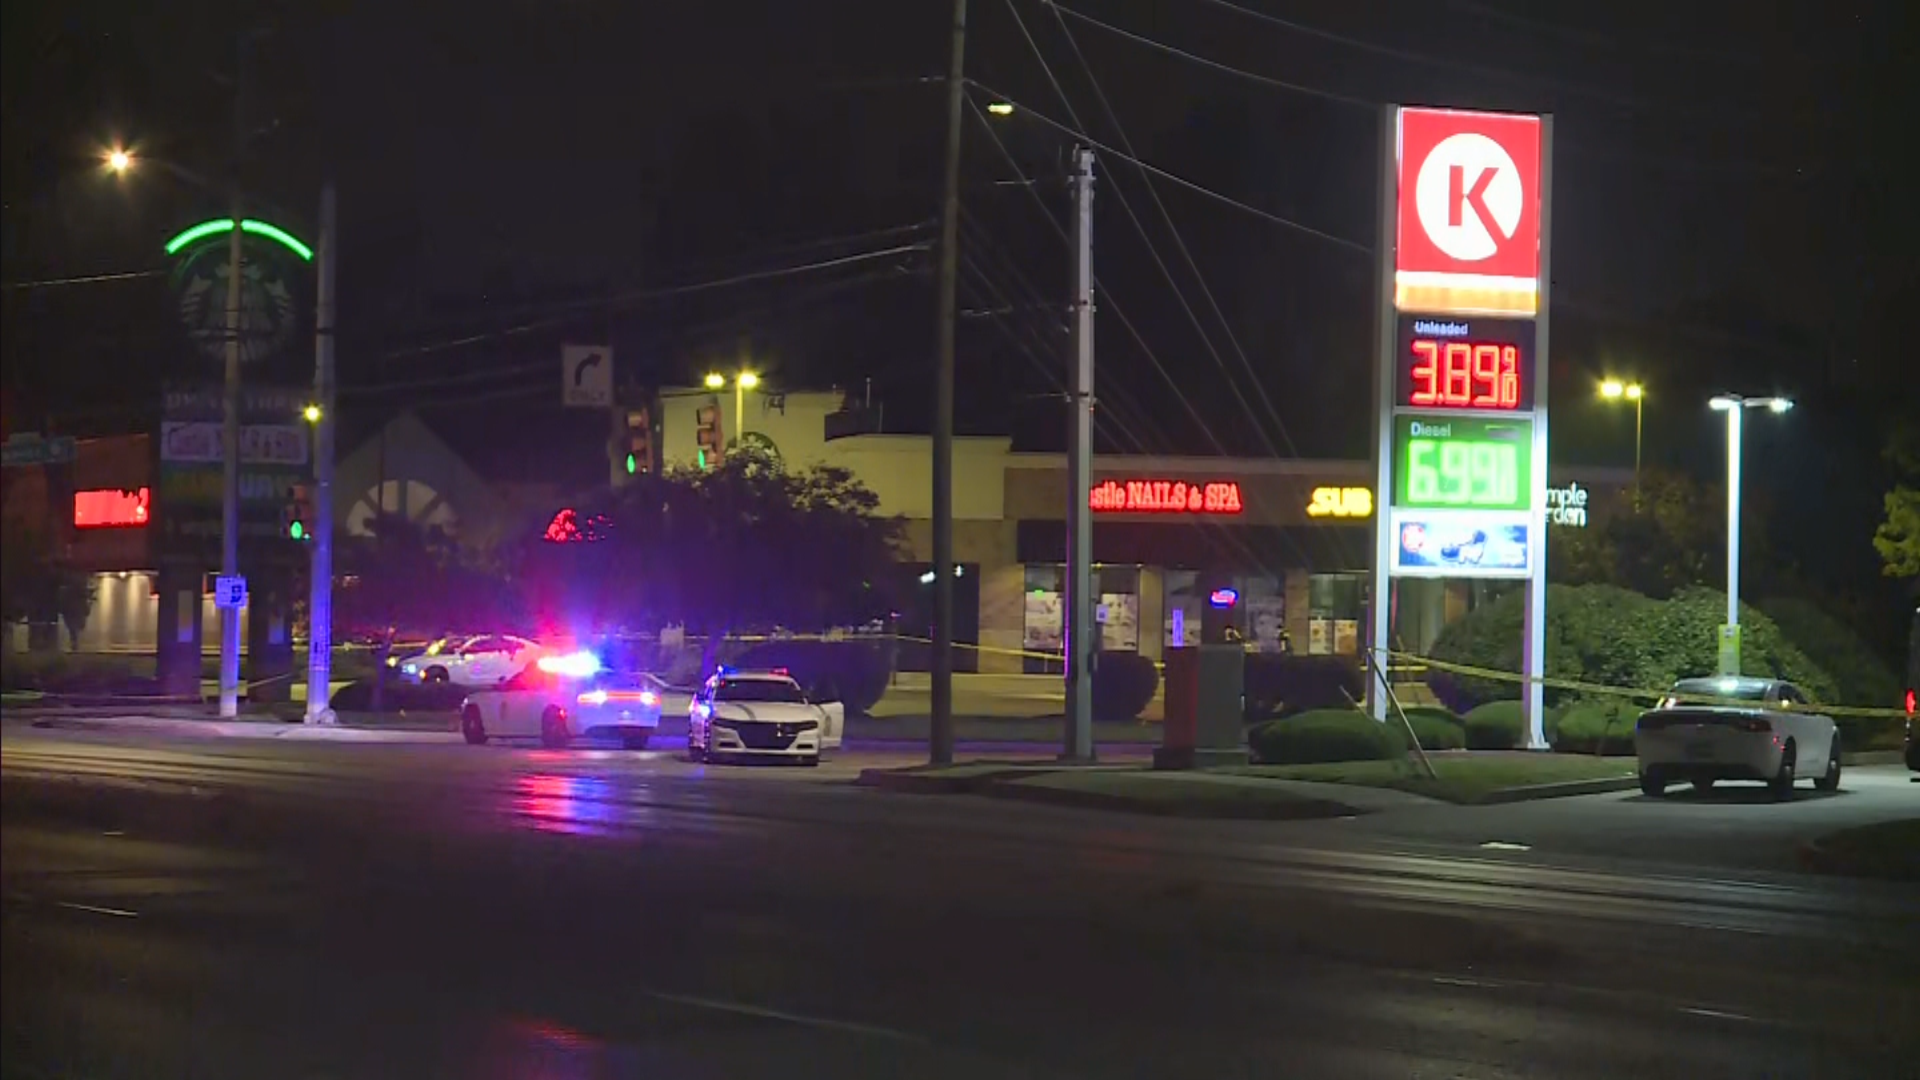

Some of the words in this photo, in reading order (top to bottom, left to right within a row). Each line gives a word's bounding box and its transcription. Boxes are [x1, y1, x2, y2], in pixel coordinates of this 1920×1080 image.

[1448, 164, 1510, 244] K
[1414, 321, 1469, 336] Unleaded
[1410, 421, 1452, 437] Diesel
[1126, 480, 1187, 510] NAILS
[1188, 484, 1203, 511] &
[1204, 482, 1241, 511] SPA
[1306, 487, 1373, 516] SUB
[1548, 481, 1588, 512] mple
